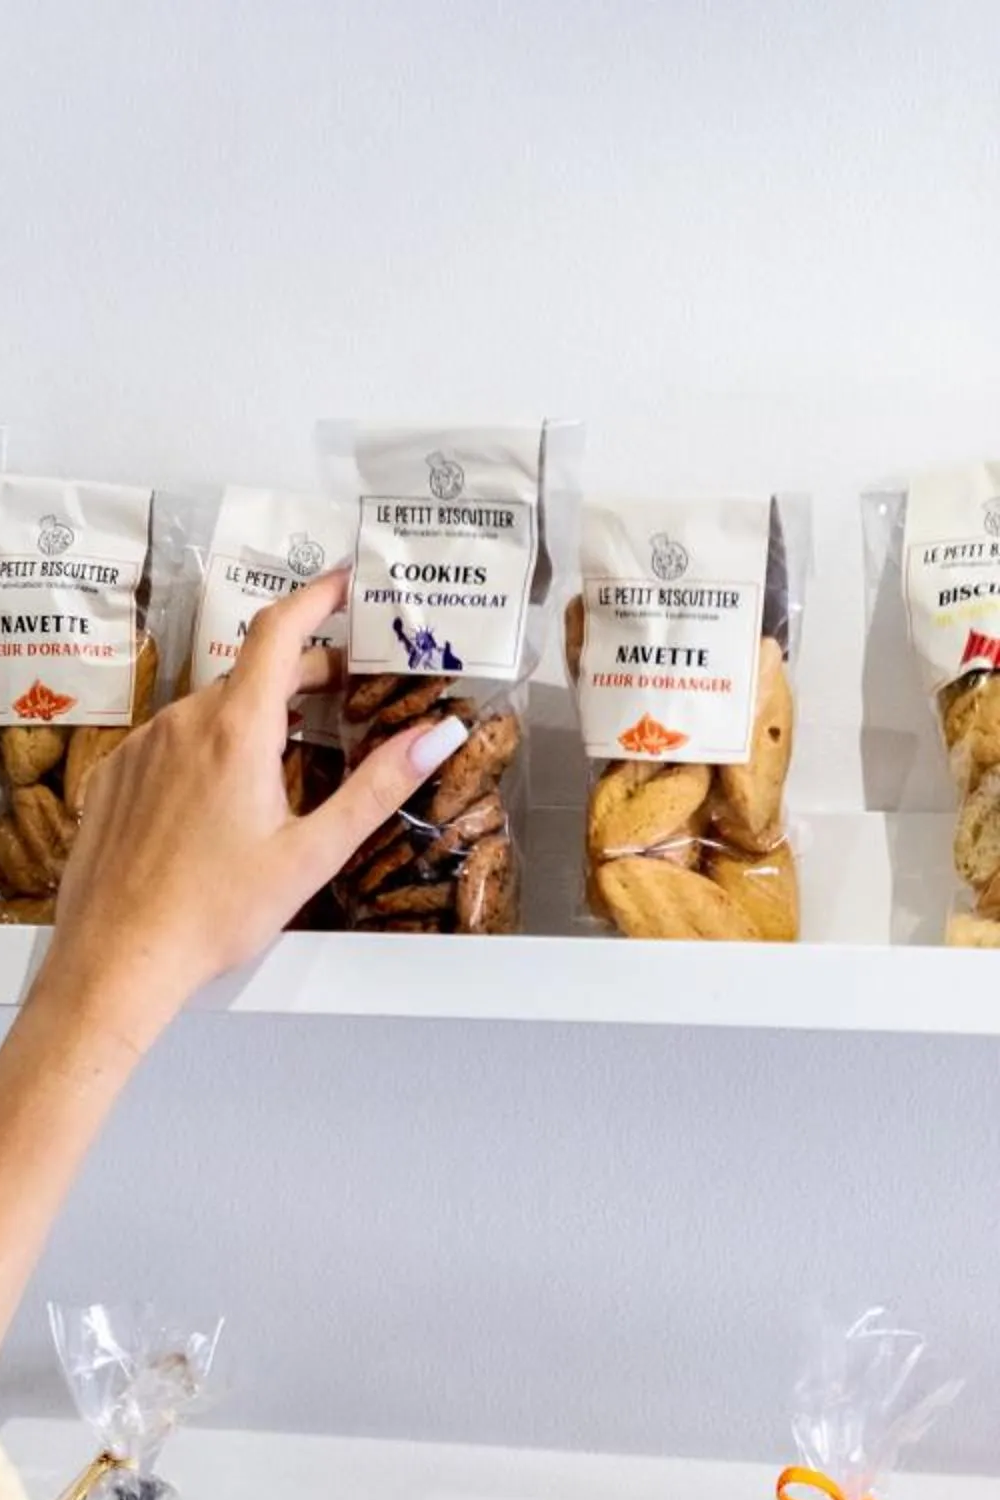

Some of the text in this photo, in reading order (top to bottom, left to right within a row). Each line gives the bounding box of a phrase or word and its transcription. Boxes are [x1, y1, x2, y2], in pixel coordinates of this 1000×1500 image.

[377, 505, 515, 528] LE PETIT BISCUITIER
[924, 547, 938, 564] LE
[944, 544, 984, 560] PETIT
[0, 561, 37, 577] PETIT
[40, 560, 120, 585] BISCUITIER
[226, 565, 241, 583] LE
[245, 570, 287, 592] PETIT
[390, 562, 487, 585] COOKIES
[364, 589, 508, 607] PEPITES CHOCOLAT
[599, 587, 740, 608] LE PETIT BISCUITIER
[1, 615, 90, 634] NAVETTE
[616, 645, 709, 667] NAVETTE
[593, 673, 633, 687] FLEUR
